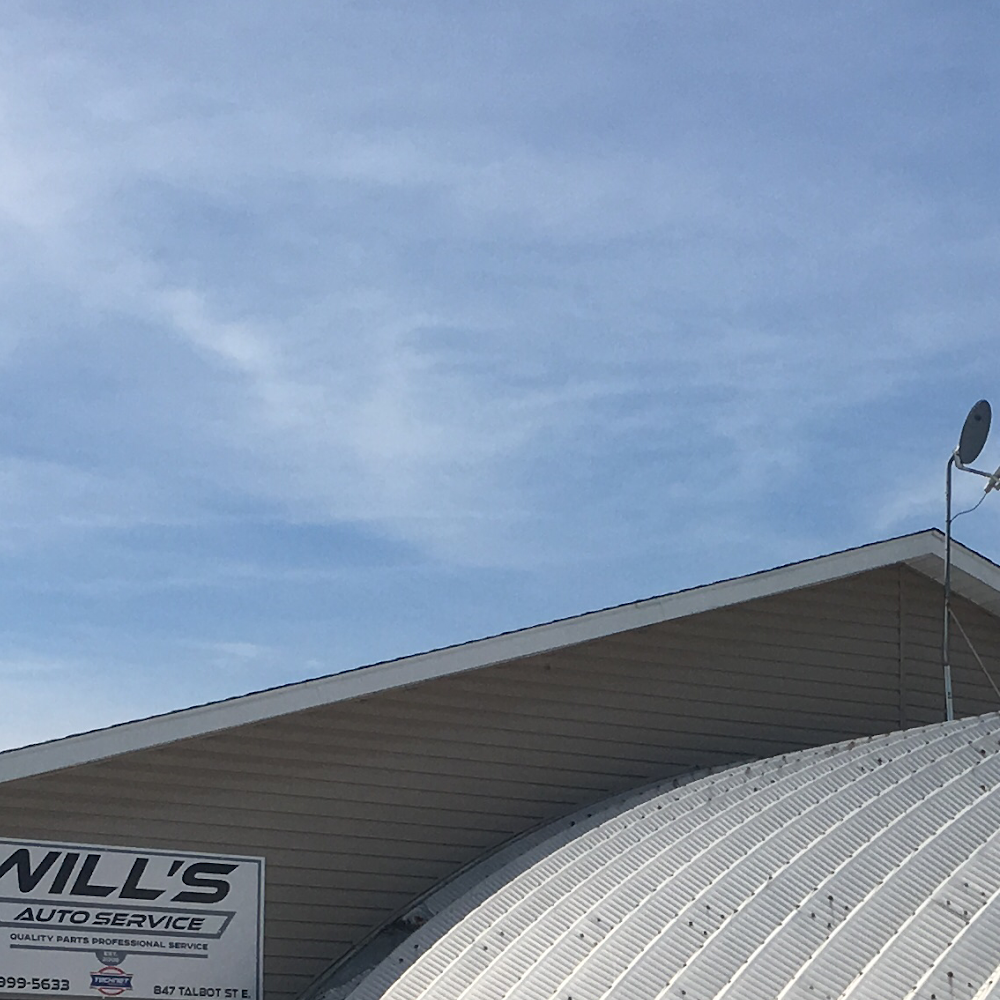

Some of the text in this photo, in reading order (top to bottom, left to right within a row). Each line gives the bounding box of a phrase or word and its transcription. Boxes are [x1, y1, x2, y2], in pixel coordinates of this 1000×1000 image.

[0, 848, 239, 904] WILL'S
[14, 907, 205, 931] AUTO SERVICE
[10, 933, 208, 951] QUALITY PARTS PROFESSIONAL SERVICE
[154, 985, 251, 999] 847 TALBOT ST E.
